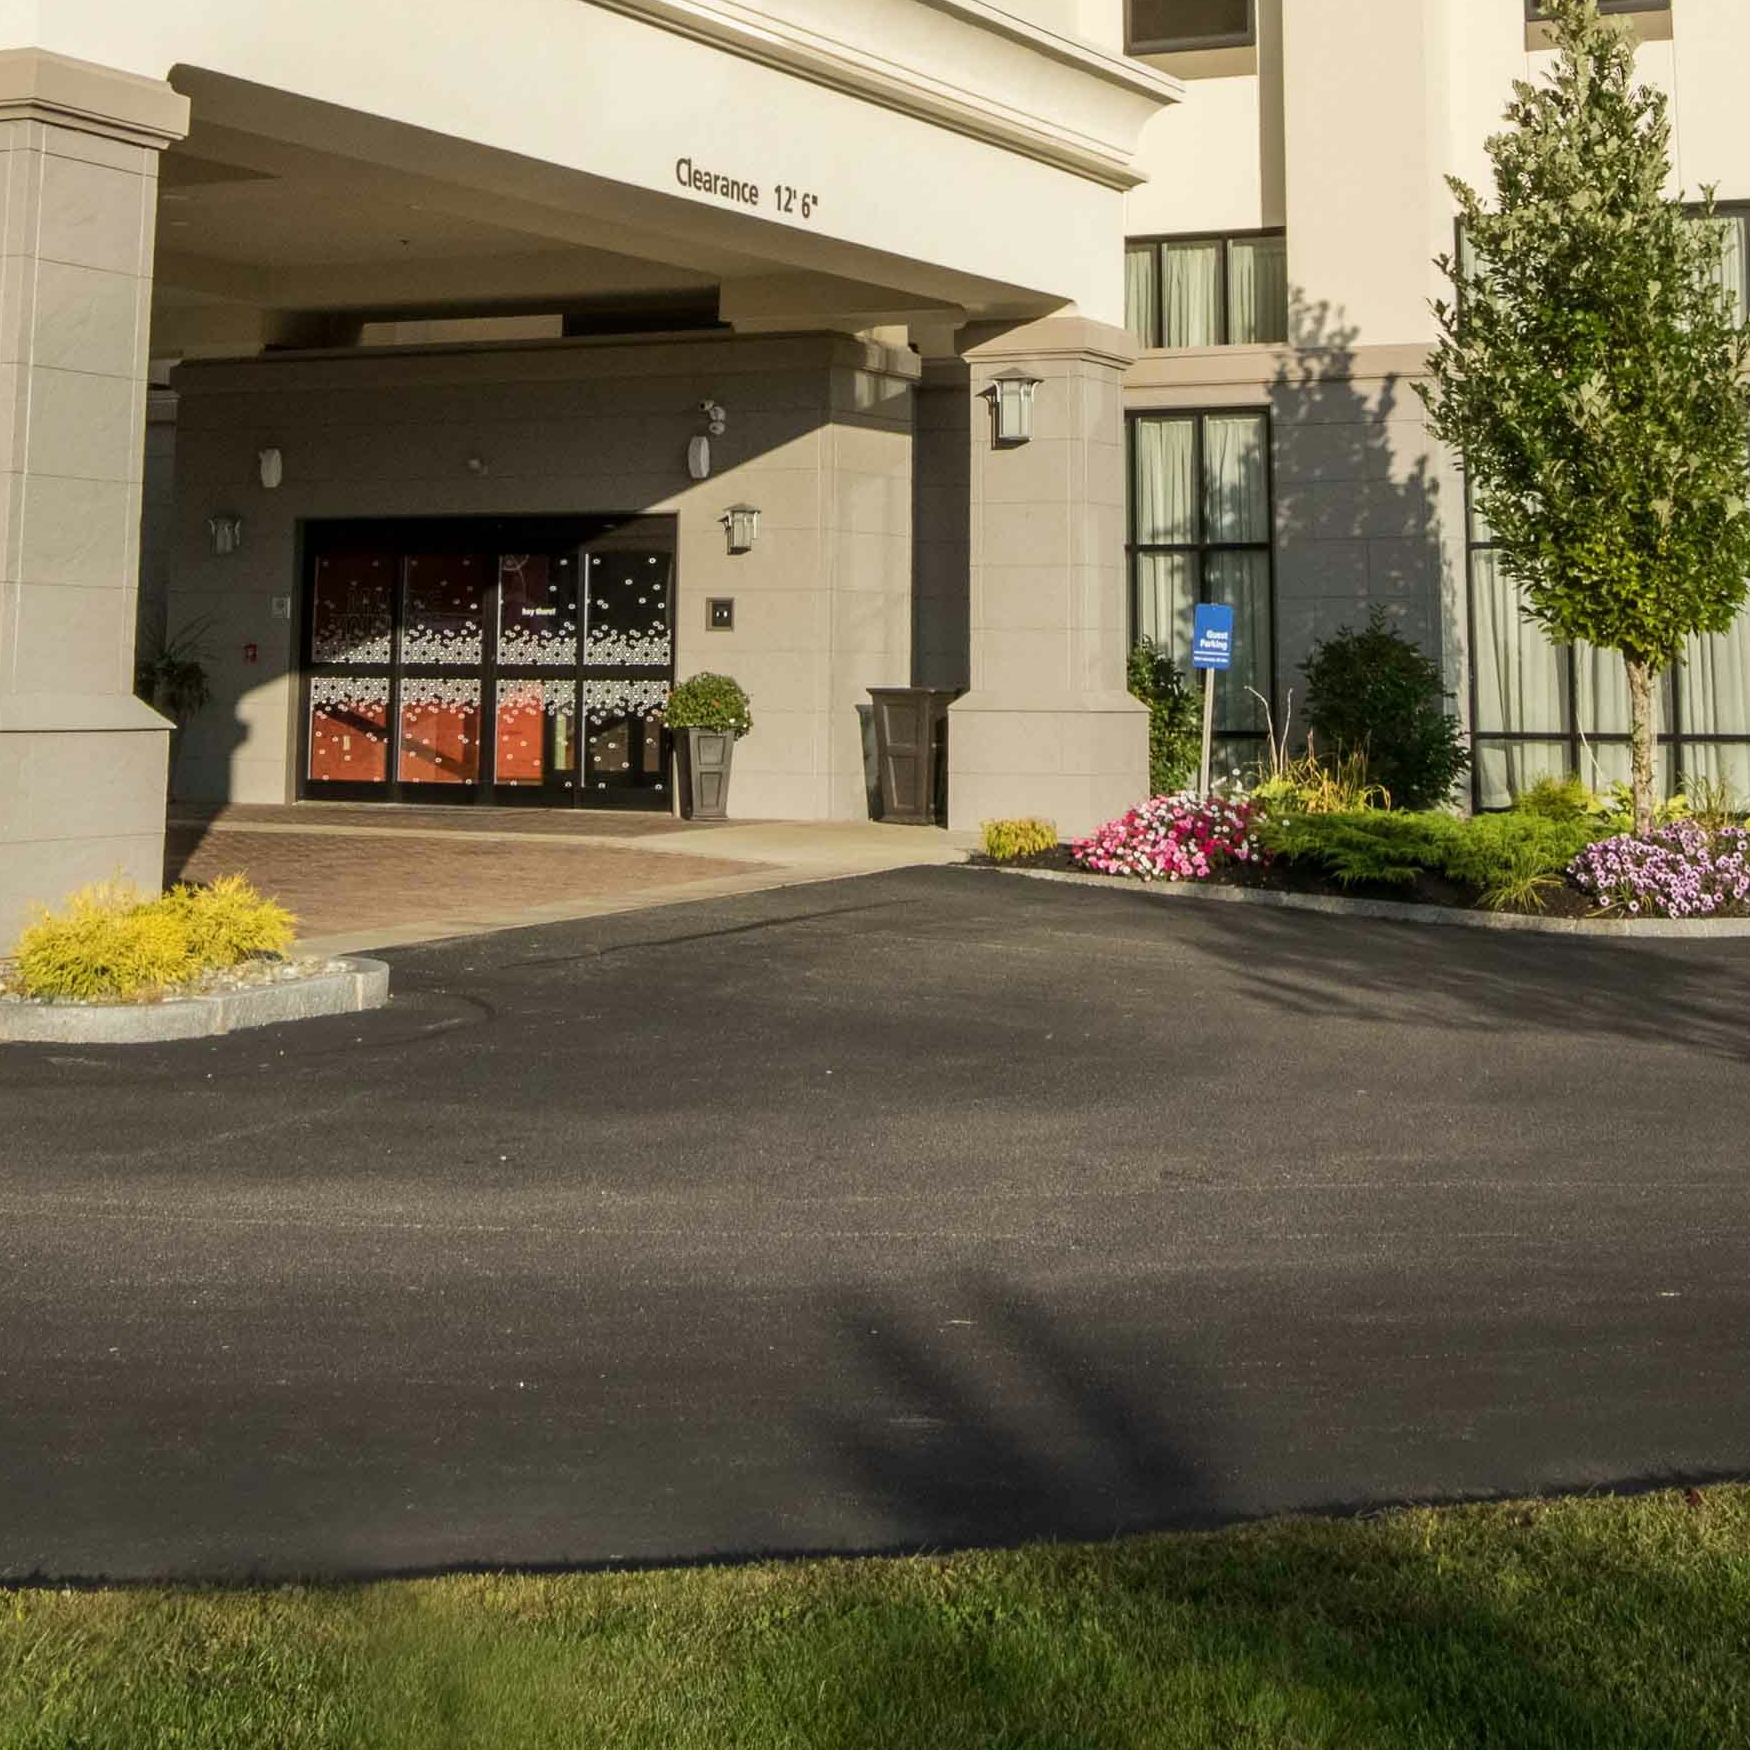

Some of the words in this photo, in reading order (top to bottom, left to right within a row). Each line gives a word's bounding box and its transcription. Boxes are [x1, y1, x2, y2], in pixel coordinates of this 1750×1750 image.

[675, 157, 759, 206] Clearance
[1206, 629, 1228, 640] Guest
[1199, 638, 1228, 651] Parking
